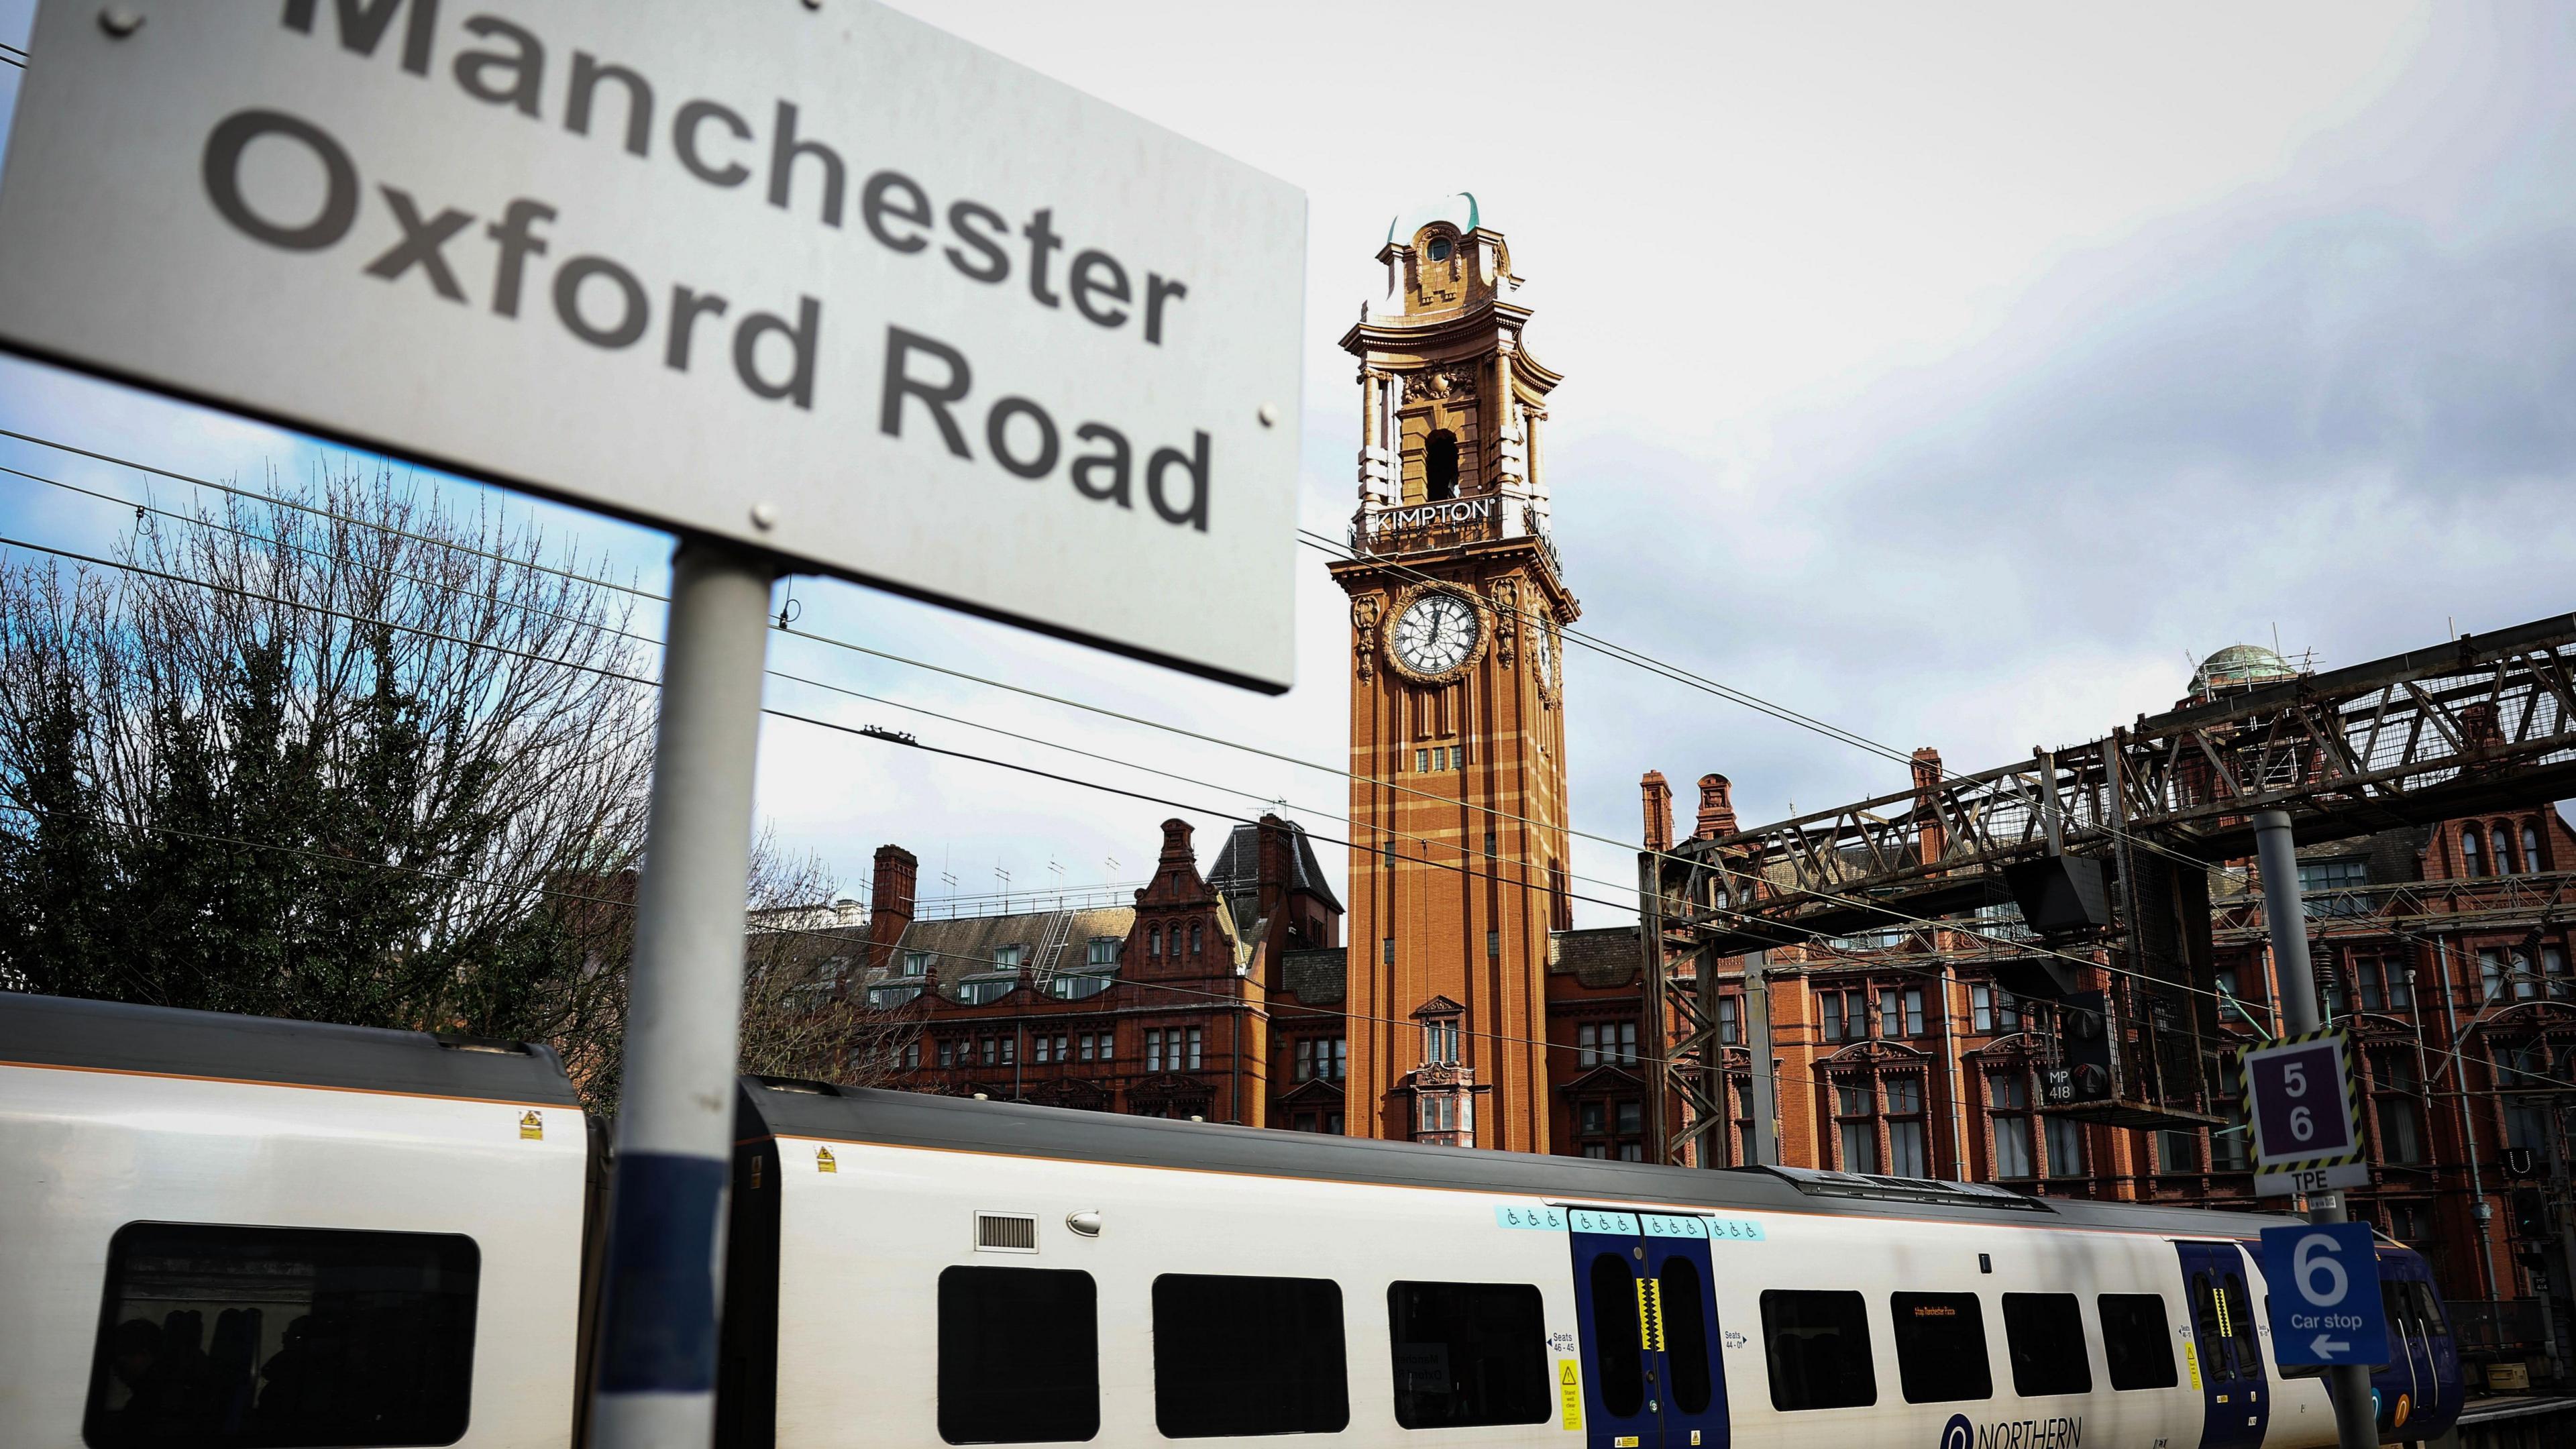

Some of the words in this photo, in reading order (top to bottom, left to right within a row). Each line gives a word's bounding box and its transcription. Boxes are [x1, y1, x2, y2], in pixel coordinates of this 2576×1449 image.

[201, 104, 821, 413] Oxford
[879, 323, 1212, 535] Road
[1376, 498, 1489, 531] KIMPTON
[2049, 1071, 2068, 1083] MP
[2284, 1062, 2307, 1097] 5
[2049, 1086, 2070, 1099] 418
[2290, 1106, 2314, 1142] 6
[2292, 1170, 2328, 1191] TPE
[2293, 1233, 2349, 1307] 6
[2292, 1314, 2319, 1328] Car
[2324, 1313, 2363, 1330] stop
[1553, 1332, 1572, 1342] Seats
[1725, 1331, 1741, 1339] Seats
[1554, 1343, 1562, 1352] 46
[1567, 1343, 1574, 1352] 45
[1726, 1341, 1733, 1349] 44
[1978, 1416, 2082, 1449] NORTHERN
